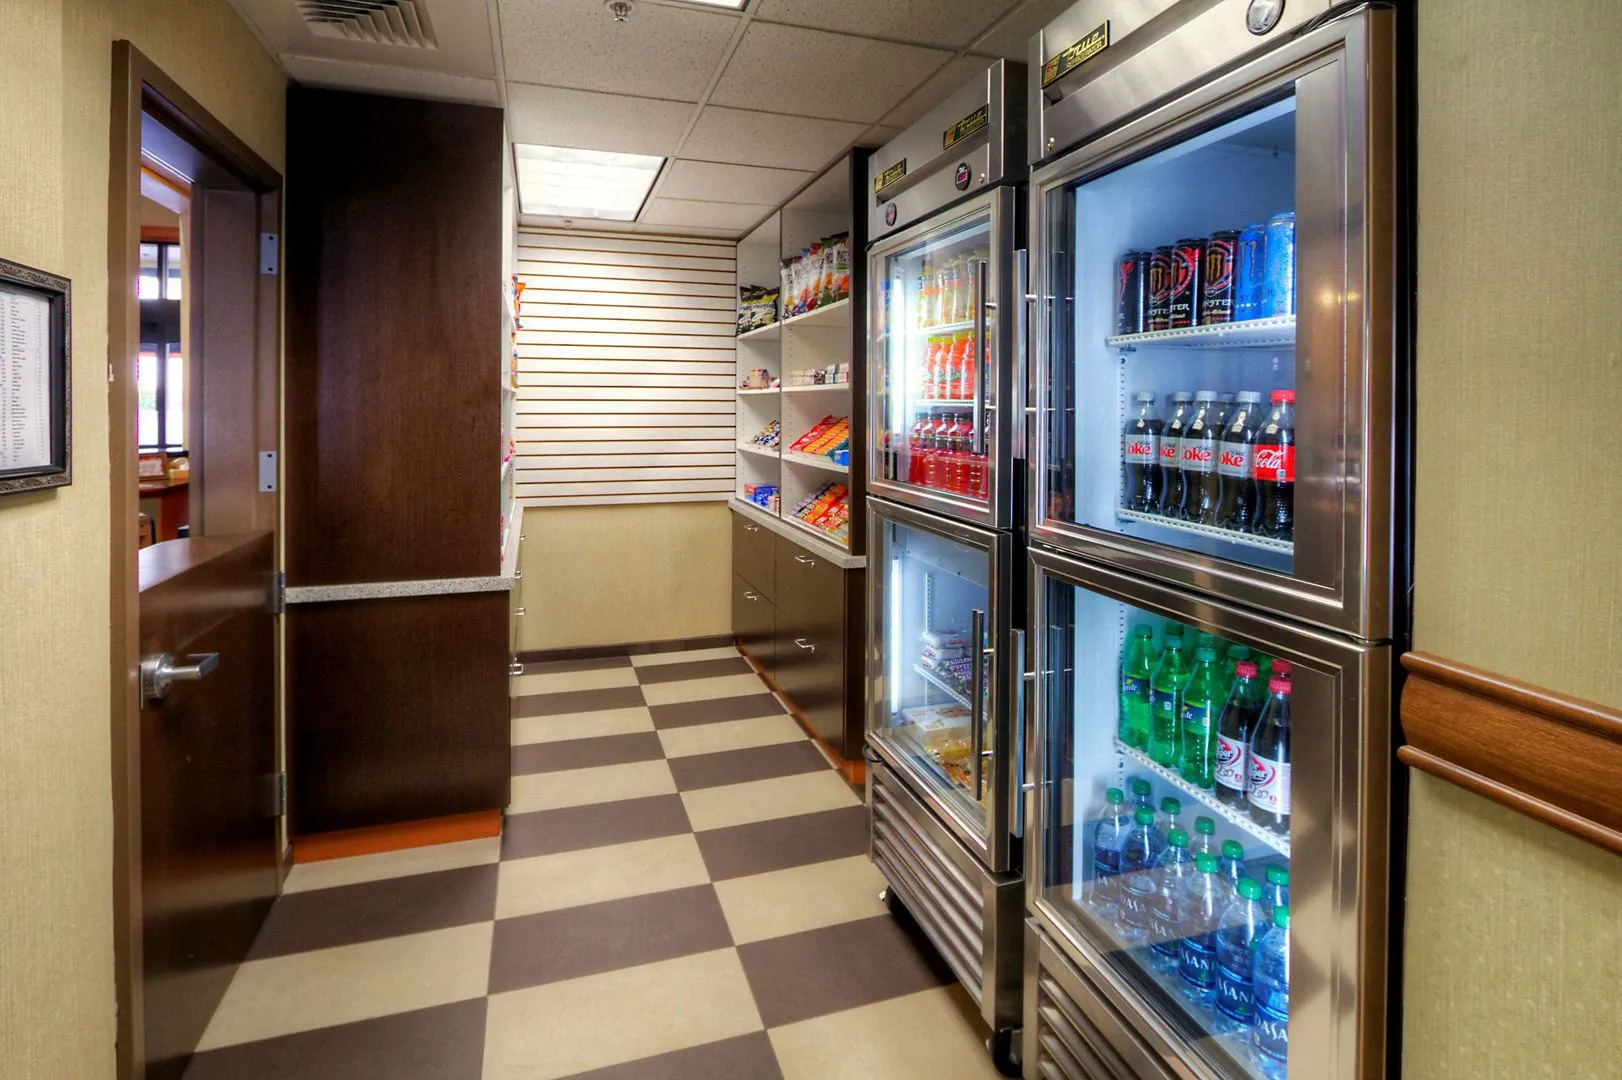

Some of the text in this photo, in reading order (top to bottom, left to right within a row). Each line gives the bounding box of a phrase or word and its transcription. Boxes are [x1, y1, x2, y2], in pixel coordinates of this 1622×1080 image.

[1127, 441, 1152, 456] oke
[1160, 445, 1176, 458] ke
[1181, 446, 1212, 463] oke
[1218, 450, 1244, 468] oke
[1254, 1012, 1289, 1042] DASA
